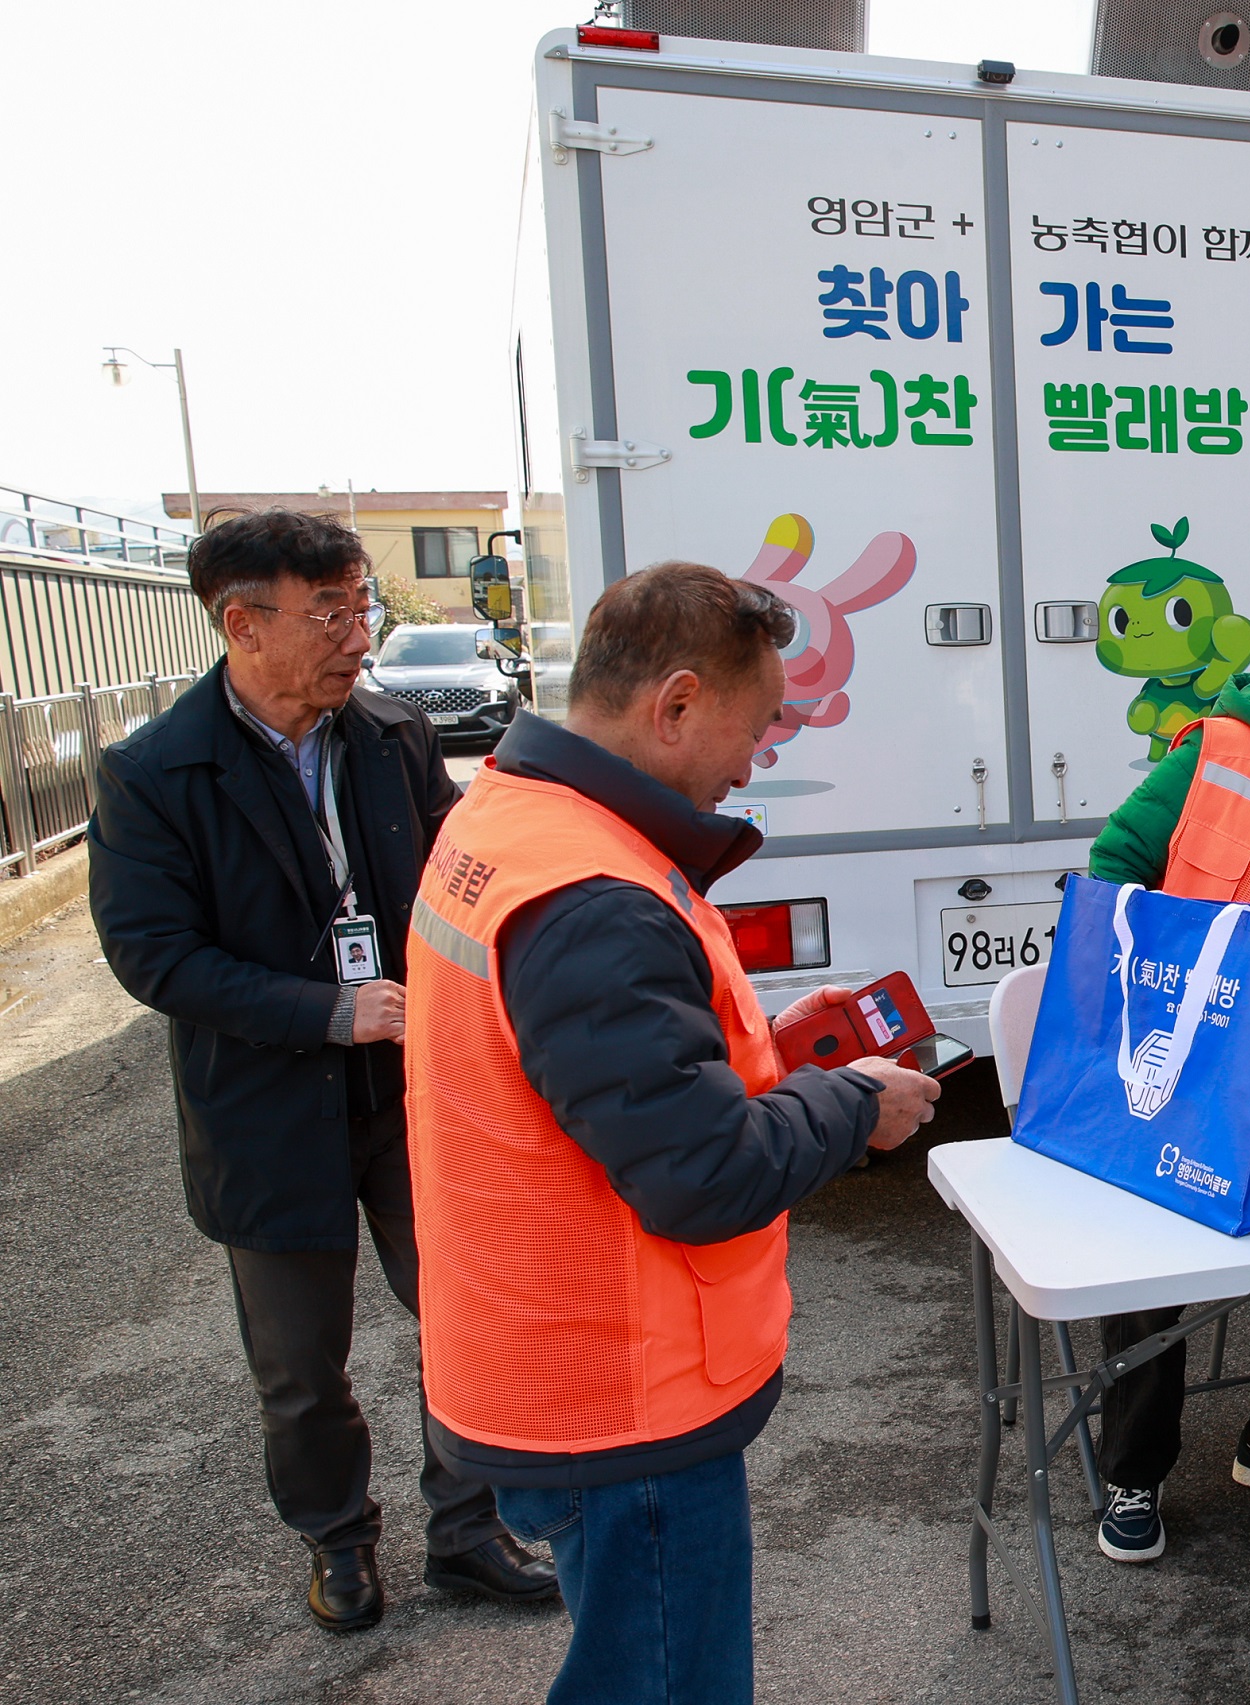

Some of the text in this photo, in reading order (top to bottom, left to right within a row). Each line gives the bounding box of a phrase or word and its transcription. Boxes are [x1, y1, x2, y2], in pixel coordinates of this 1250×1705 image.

[807, 196, 936, 240] 영암군
[1030, 214, 1187, 259] 농축협이
[817, 264, 1175, 355] 찾아 가는
[686, 366, 1249, 456] 기(氣)찬 빨래방
[1176, 1162, 1232, 1197] 영암시니어클럽
